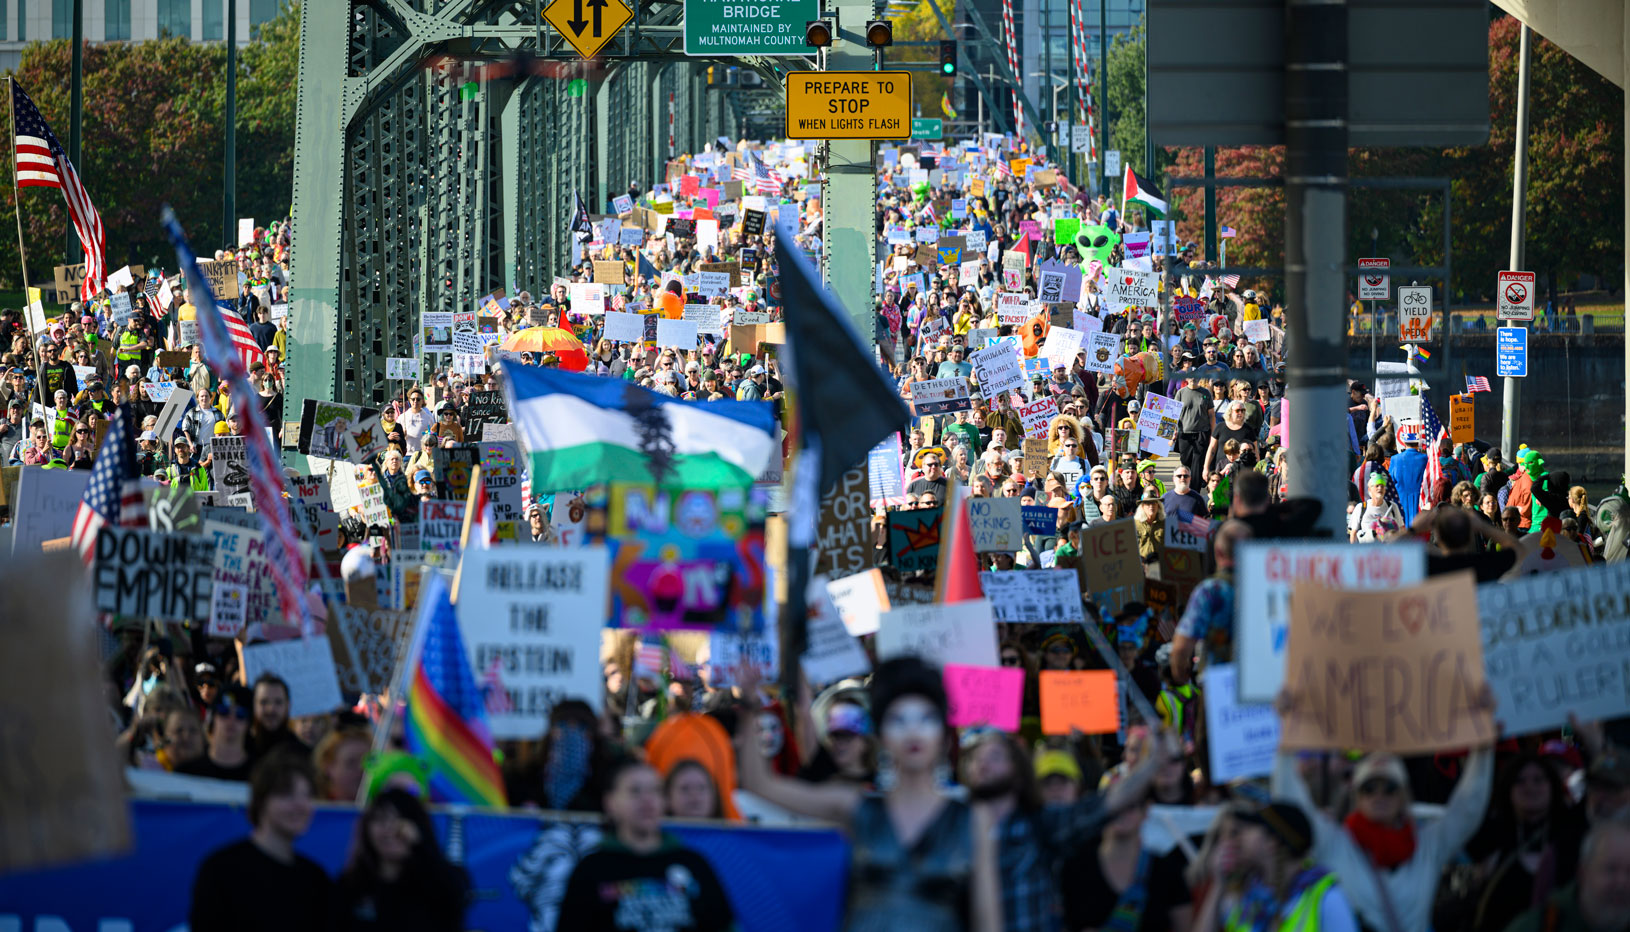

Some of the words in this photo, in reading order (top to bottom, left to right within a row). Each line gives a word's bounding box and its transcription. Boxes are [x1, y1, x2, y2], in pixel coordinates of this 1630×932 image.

[723, 5, 781, 18] BRIDGE
[711, 23, 774, 33] MAINTAINED
[778, 23, 792, 33] BY
[698, 35, 761, 46] MULTNOMAH
[763, 35, 805, 45] COUNTY
[804, 81, 870, 94] PREPARE
[876, 81, 894, 94] TO
[828, 98, 870, 114] STOP
[798, 118, 826, 130] WHEN
[830, 118, 864, 130] LIGHTS
[868, 118, 900, 130] FLASH
[1111, 283, 1156, 298] AMERICA
[1118, 295, 1149, 305] PROTEST
[1178, 303, 1201, 313] OUR
[1403, 307, 1428, 316] YIELD
[453, 313, 475, 321] DON'T
[1410, 317, 1421, 326] TO
[921, 326, 931, 335] NO
[1405, 328, 1426, 337] PEDS
[1505, 336, 1519, 344] hope.
[971, 345, 1011, 370] INHUMANE
[1090, 362, 1112, 370] FASCISM
[914, 378, 961, 391] DETHRONE
[475, 396, 488, 405] NO
[471, 408, 491, 417] since
[1019, 397, 1057, 418] FACISM
[1033, 420, 1048, 431] NO
[213, 451, 246, 461] SNAKE
[453, 450, 472, 461] OUR
[291, 476, 306, 486] We
[361, 485, 382, 498] POWER
[363, 499, 372, 509] OF
[373, 496, 385, 507] THE
[817, 491, 867, 523] FOR
[970, 501, 991, 517] NO
[365, 510, 388, 524] PEOPLE
[1027, 521, 1047, 529] ALL
[814, 517, 870, 550] WHAT
[98, 529, 189, 567] DOWN
[212, 530, 240, 553] THE
[1091, 528, 1127, 558] ICE
[223, 553, 243, 572] THE
[825, 545, 865, 570] IS
[1352, 549, 1403, 584] YOU
[485, 561, 585, 595] RELEASE
[94, 564, 212, 621] EMPIRE
[508, 603, 551, 634] THE
[1301, 594, 1361, 644] WE
[474, 644, 575, 676] EPSTEIN
[1286, 650, 1492, 747] AMERICA
